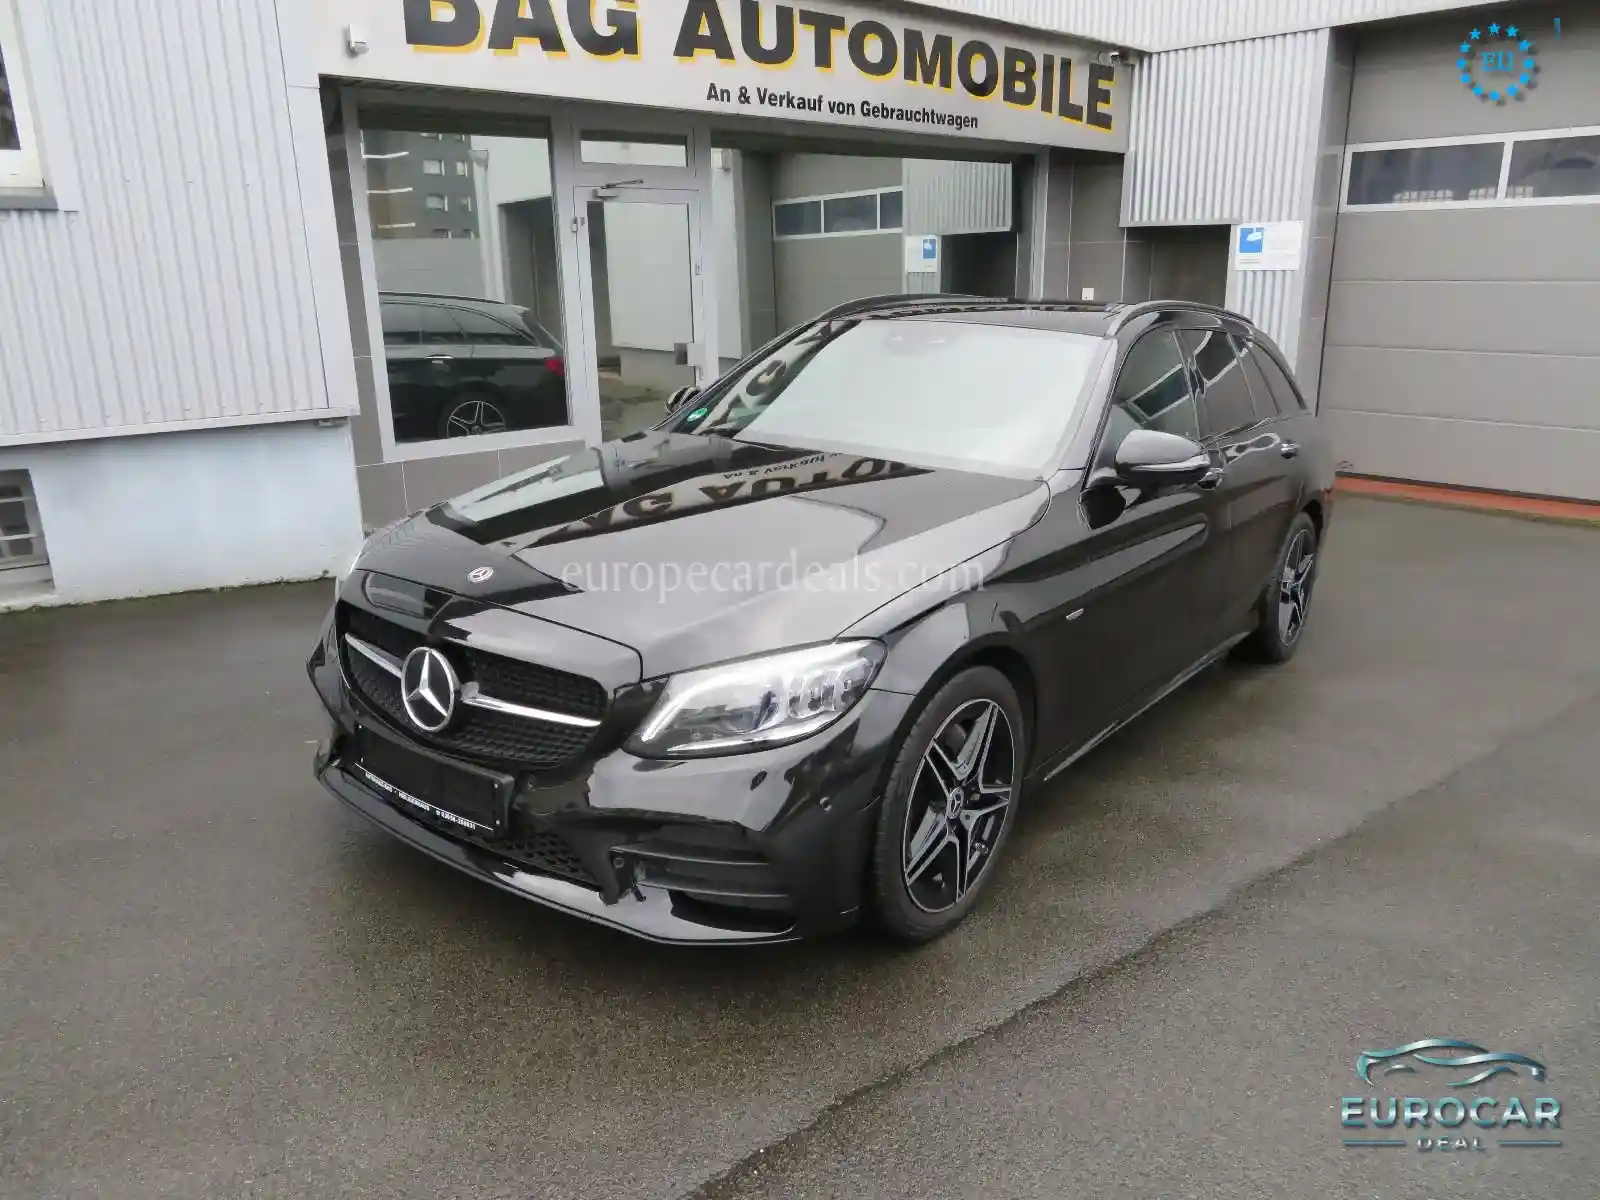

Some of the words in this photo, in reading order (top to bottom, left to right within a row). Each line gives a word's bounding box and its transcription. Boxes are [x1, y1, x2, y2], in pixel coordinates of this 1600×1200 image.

[402, 0, 640, 59] BAG
[672, 0, 1114, 131] AUTOMOBILE
[706, 82, 732, 104] An
[737, 85, 752, 105] &
[756, 86, 823, 116] Verkauf
[827, 99, 856, 118] von
[860, 101, 979, 130] Gebrauchtwagen
